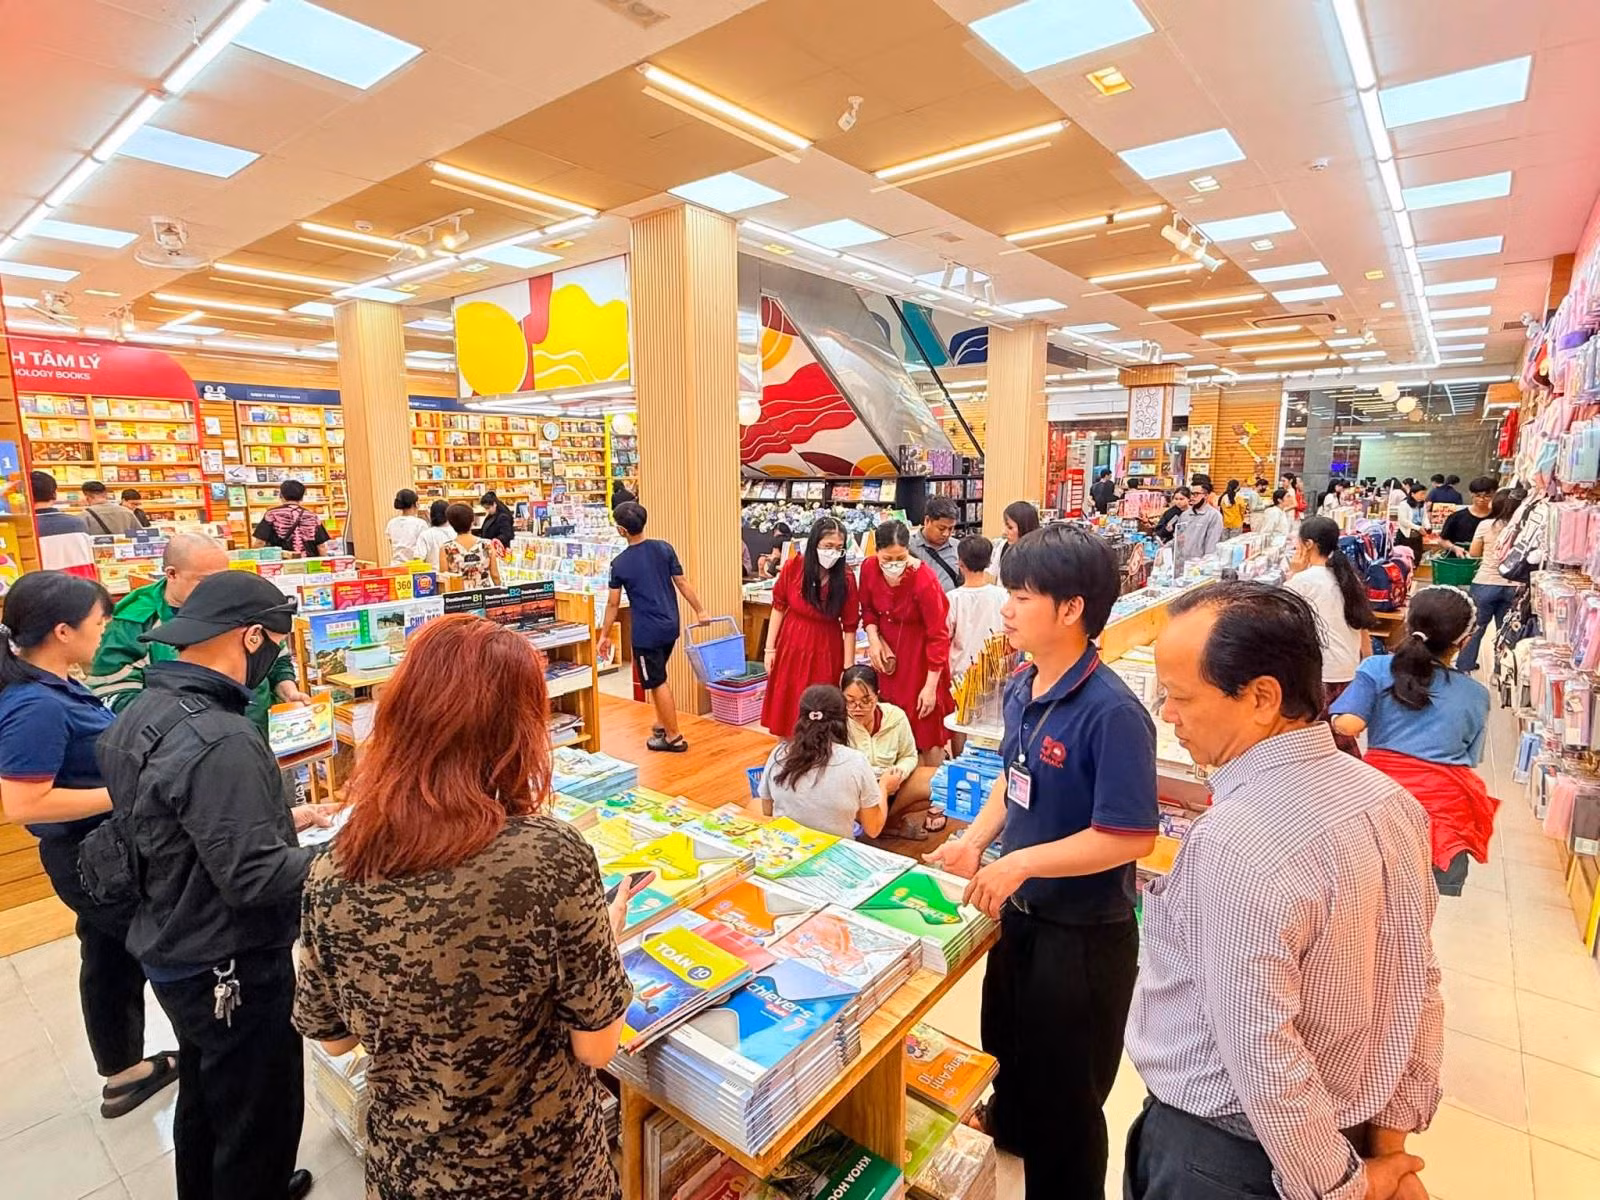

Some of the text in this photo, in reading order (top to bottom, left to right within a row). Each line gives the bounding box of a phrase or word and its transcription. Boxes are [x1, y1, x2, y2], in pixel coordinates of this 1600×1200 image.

[28, 349, 76, 368] TÂM
[78, 353, 101, 369] LÝ
[56, 371, 91, 380] BOOKS
[396, 581, 412, 591] 360
[543, 583, 554, 592] B2
[509, 588, 521, 597] B2
[472, 593, 483, 602] B1
[656, 943, 710, 979] TOÁN 10
[844, 1155, 872, 1182] KHOA
